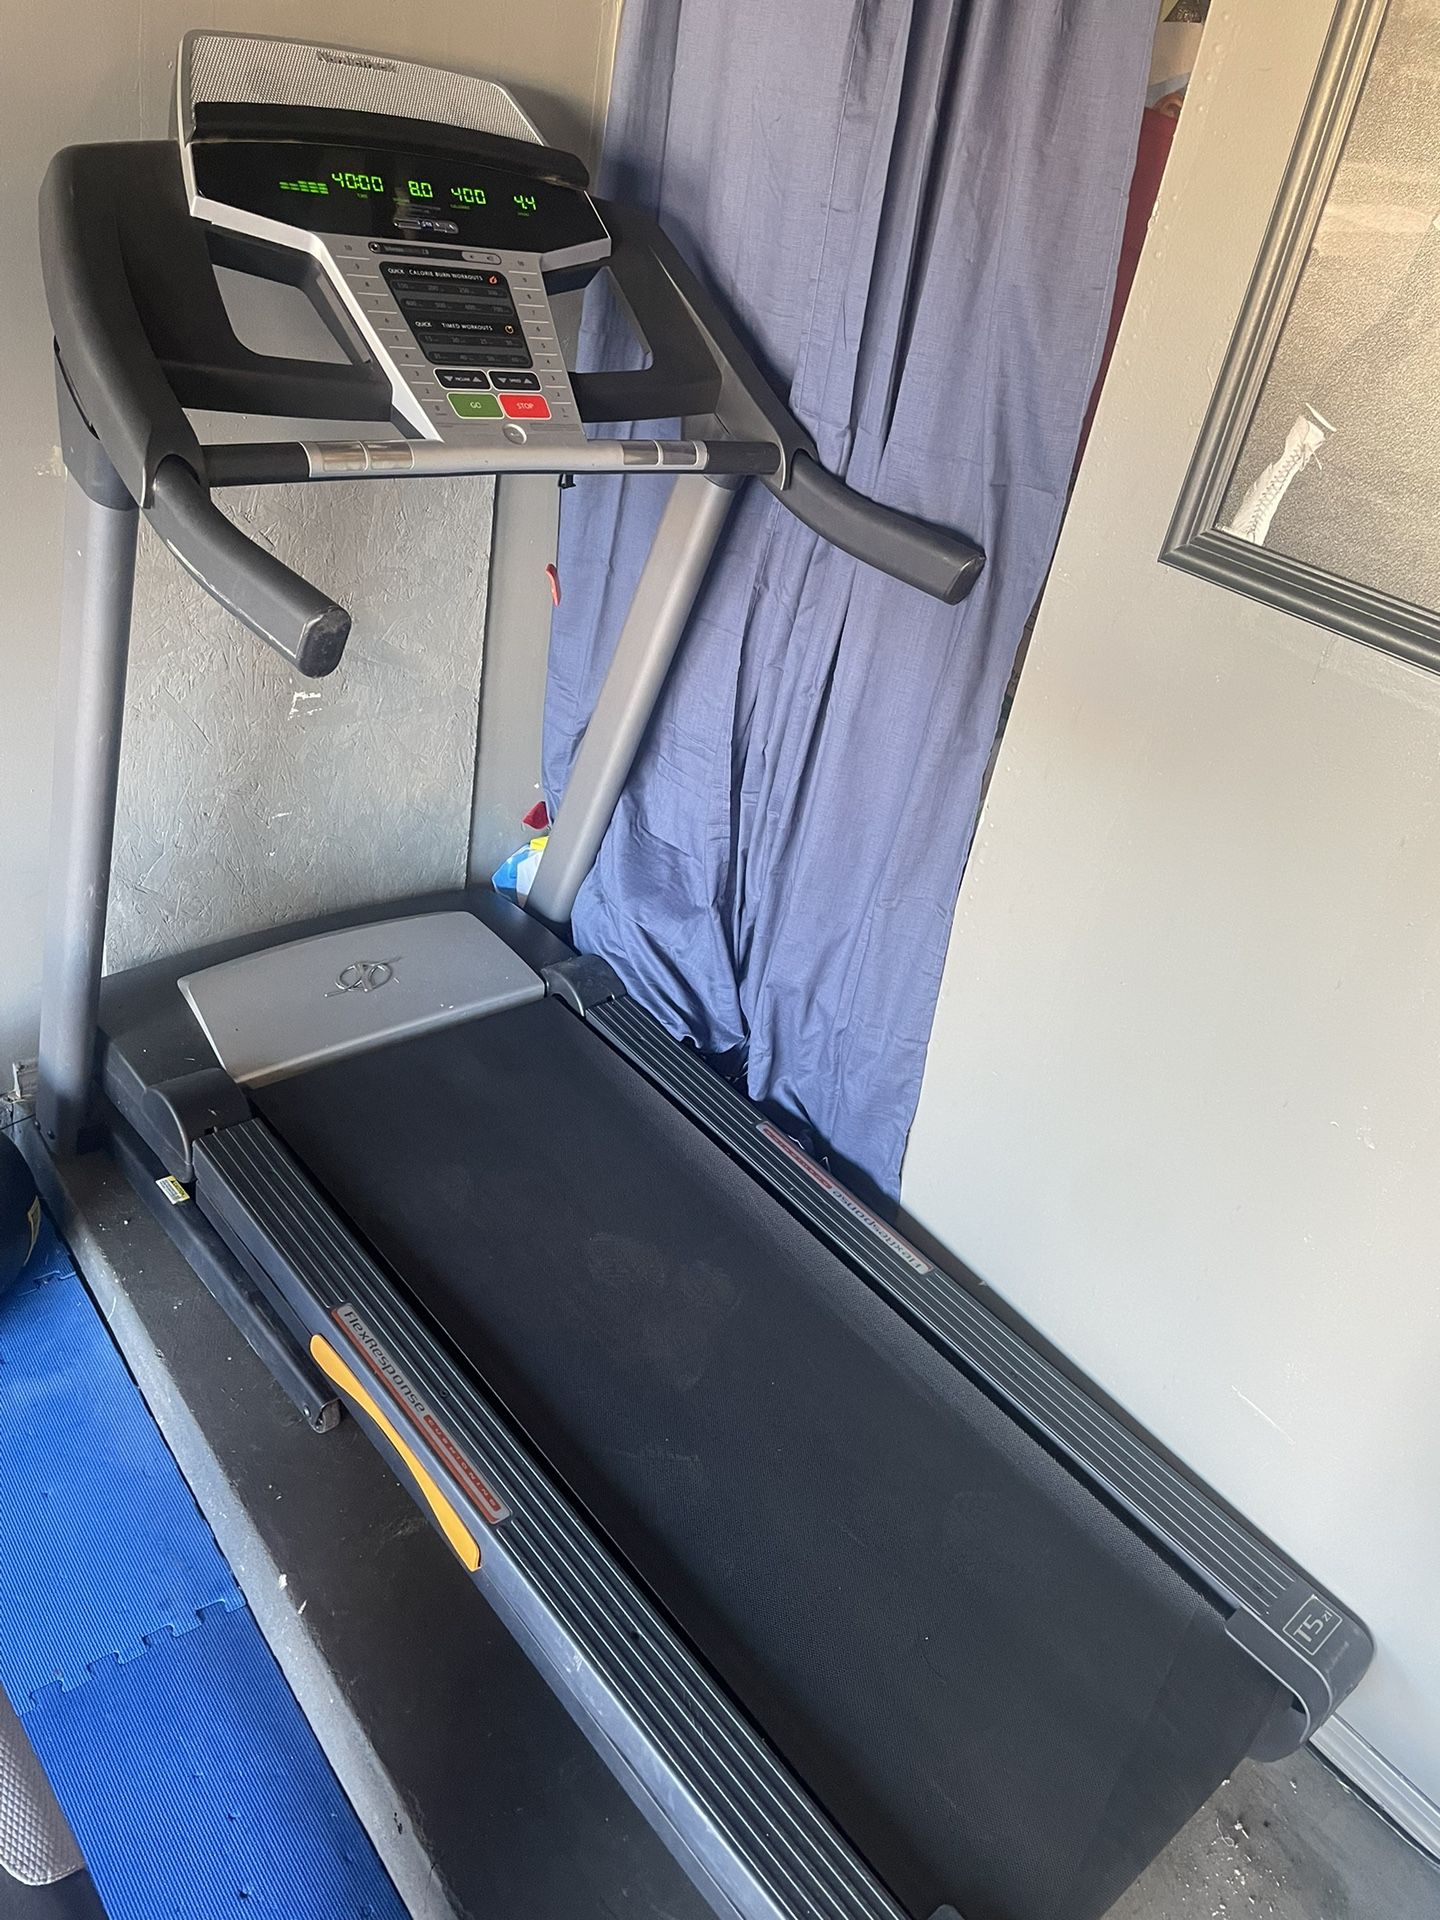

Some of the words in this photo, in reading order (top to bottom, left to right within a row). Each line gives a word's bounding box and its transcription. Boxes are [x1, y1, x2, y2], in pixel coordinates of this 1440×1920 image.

[332, 172, 384, 192] 40:00
[407, 180, 434, 198] 8.0
[450, 187, 487, 205] 400
[387, 267, 405, 275] QUICK
[408, 268, 435, 278] CALORIE
[435, 271, 451, 279] BURN
[452, 272, 484, 282] WORKOUTS
[414, 320, 433, 328] QUICK
[441, 321, 461, 330] TIMED
[461, 323, 494, 332] WORKOUTS
[469, 401, 483, 410] GO
[515, 402, 535, 411] STOP
[832, 1189, 923, 1270] FlexResponse
[344, 1311, 425, 1413] FlexResponse
